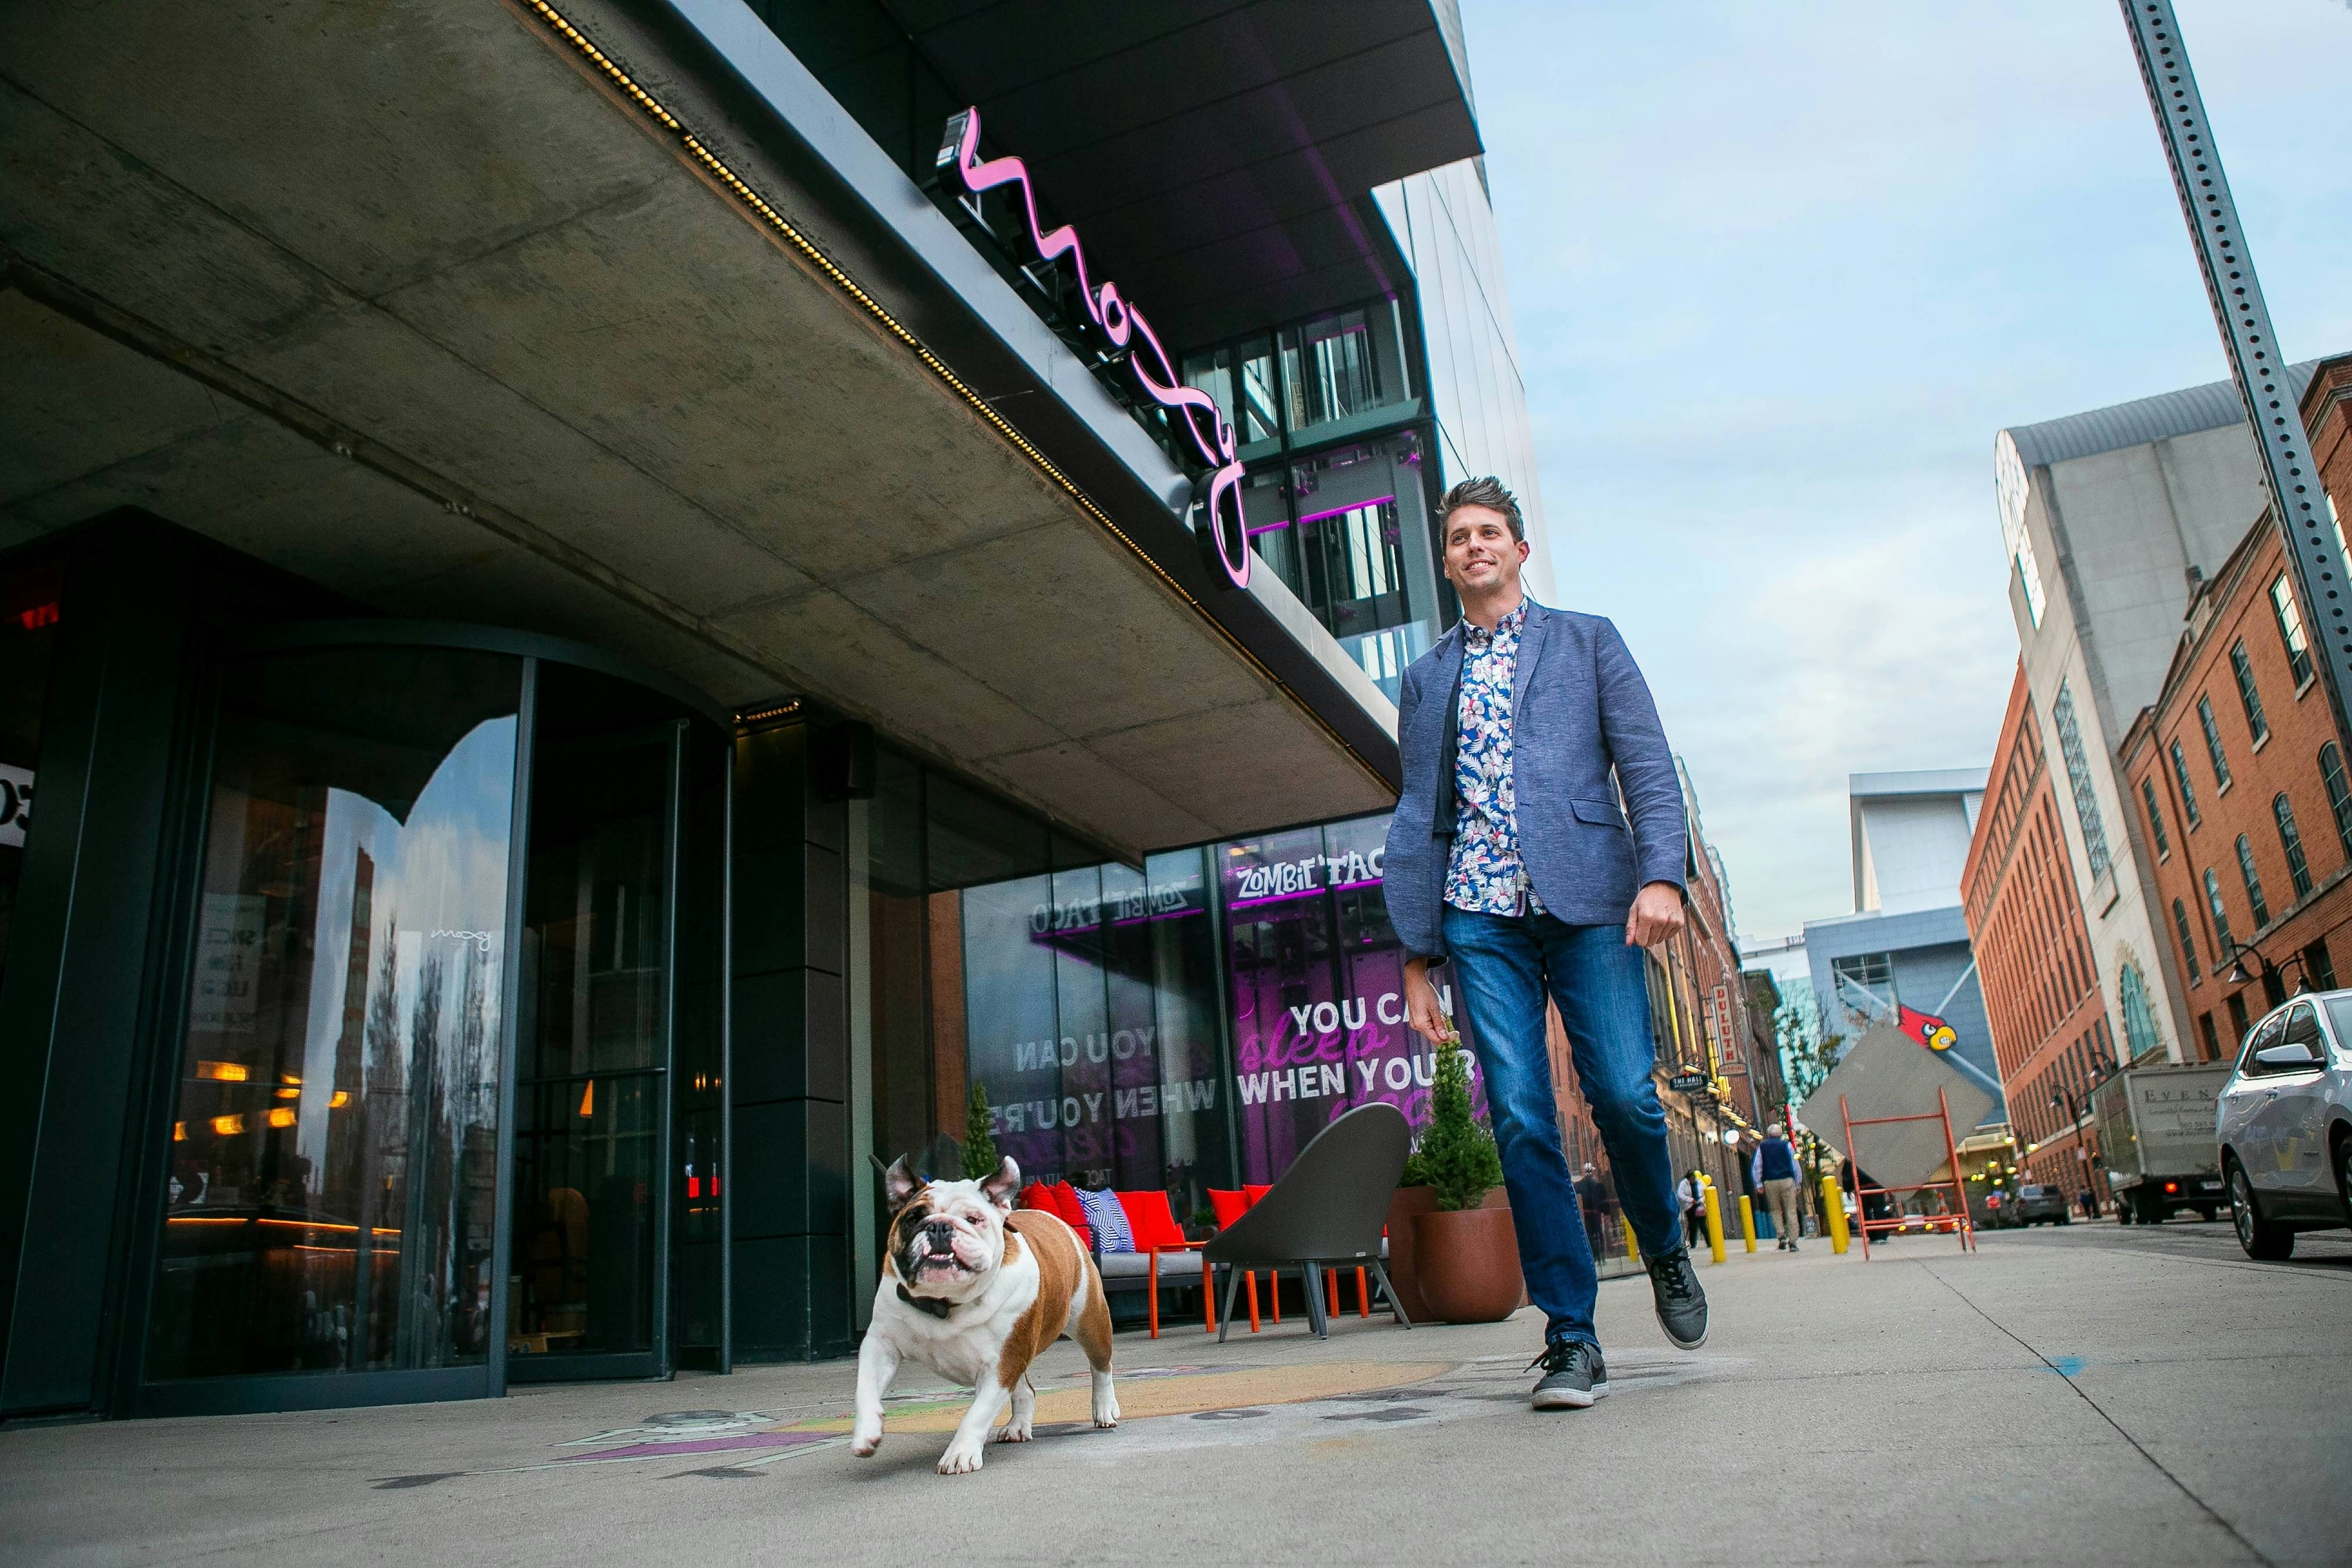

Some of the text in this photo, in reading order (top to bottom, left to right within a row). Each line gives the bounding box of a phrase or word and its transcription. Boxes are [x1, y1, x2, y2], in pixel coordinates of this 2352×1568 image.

[1318, 845, 1385, 885] TAC
[430, 930, 492, 952] moxy
[1290, 985, 1453, 1035] YOU CN
[1716, 988, 1735, 1060] DULUTH
[1242, 1010, 1389, 1071] sleep
[1238, 1062, 1345, 1105] WHEN
